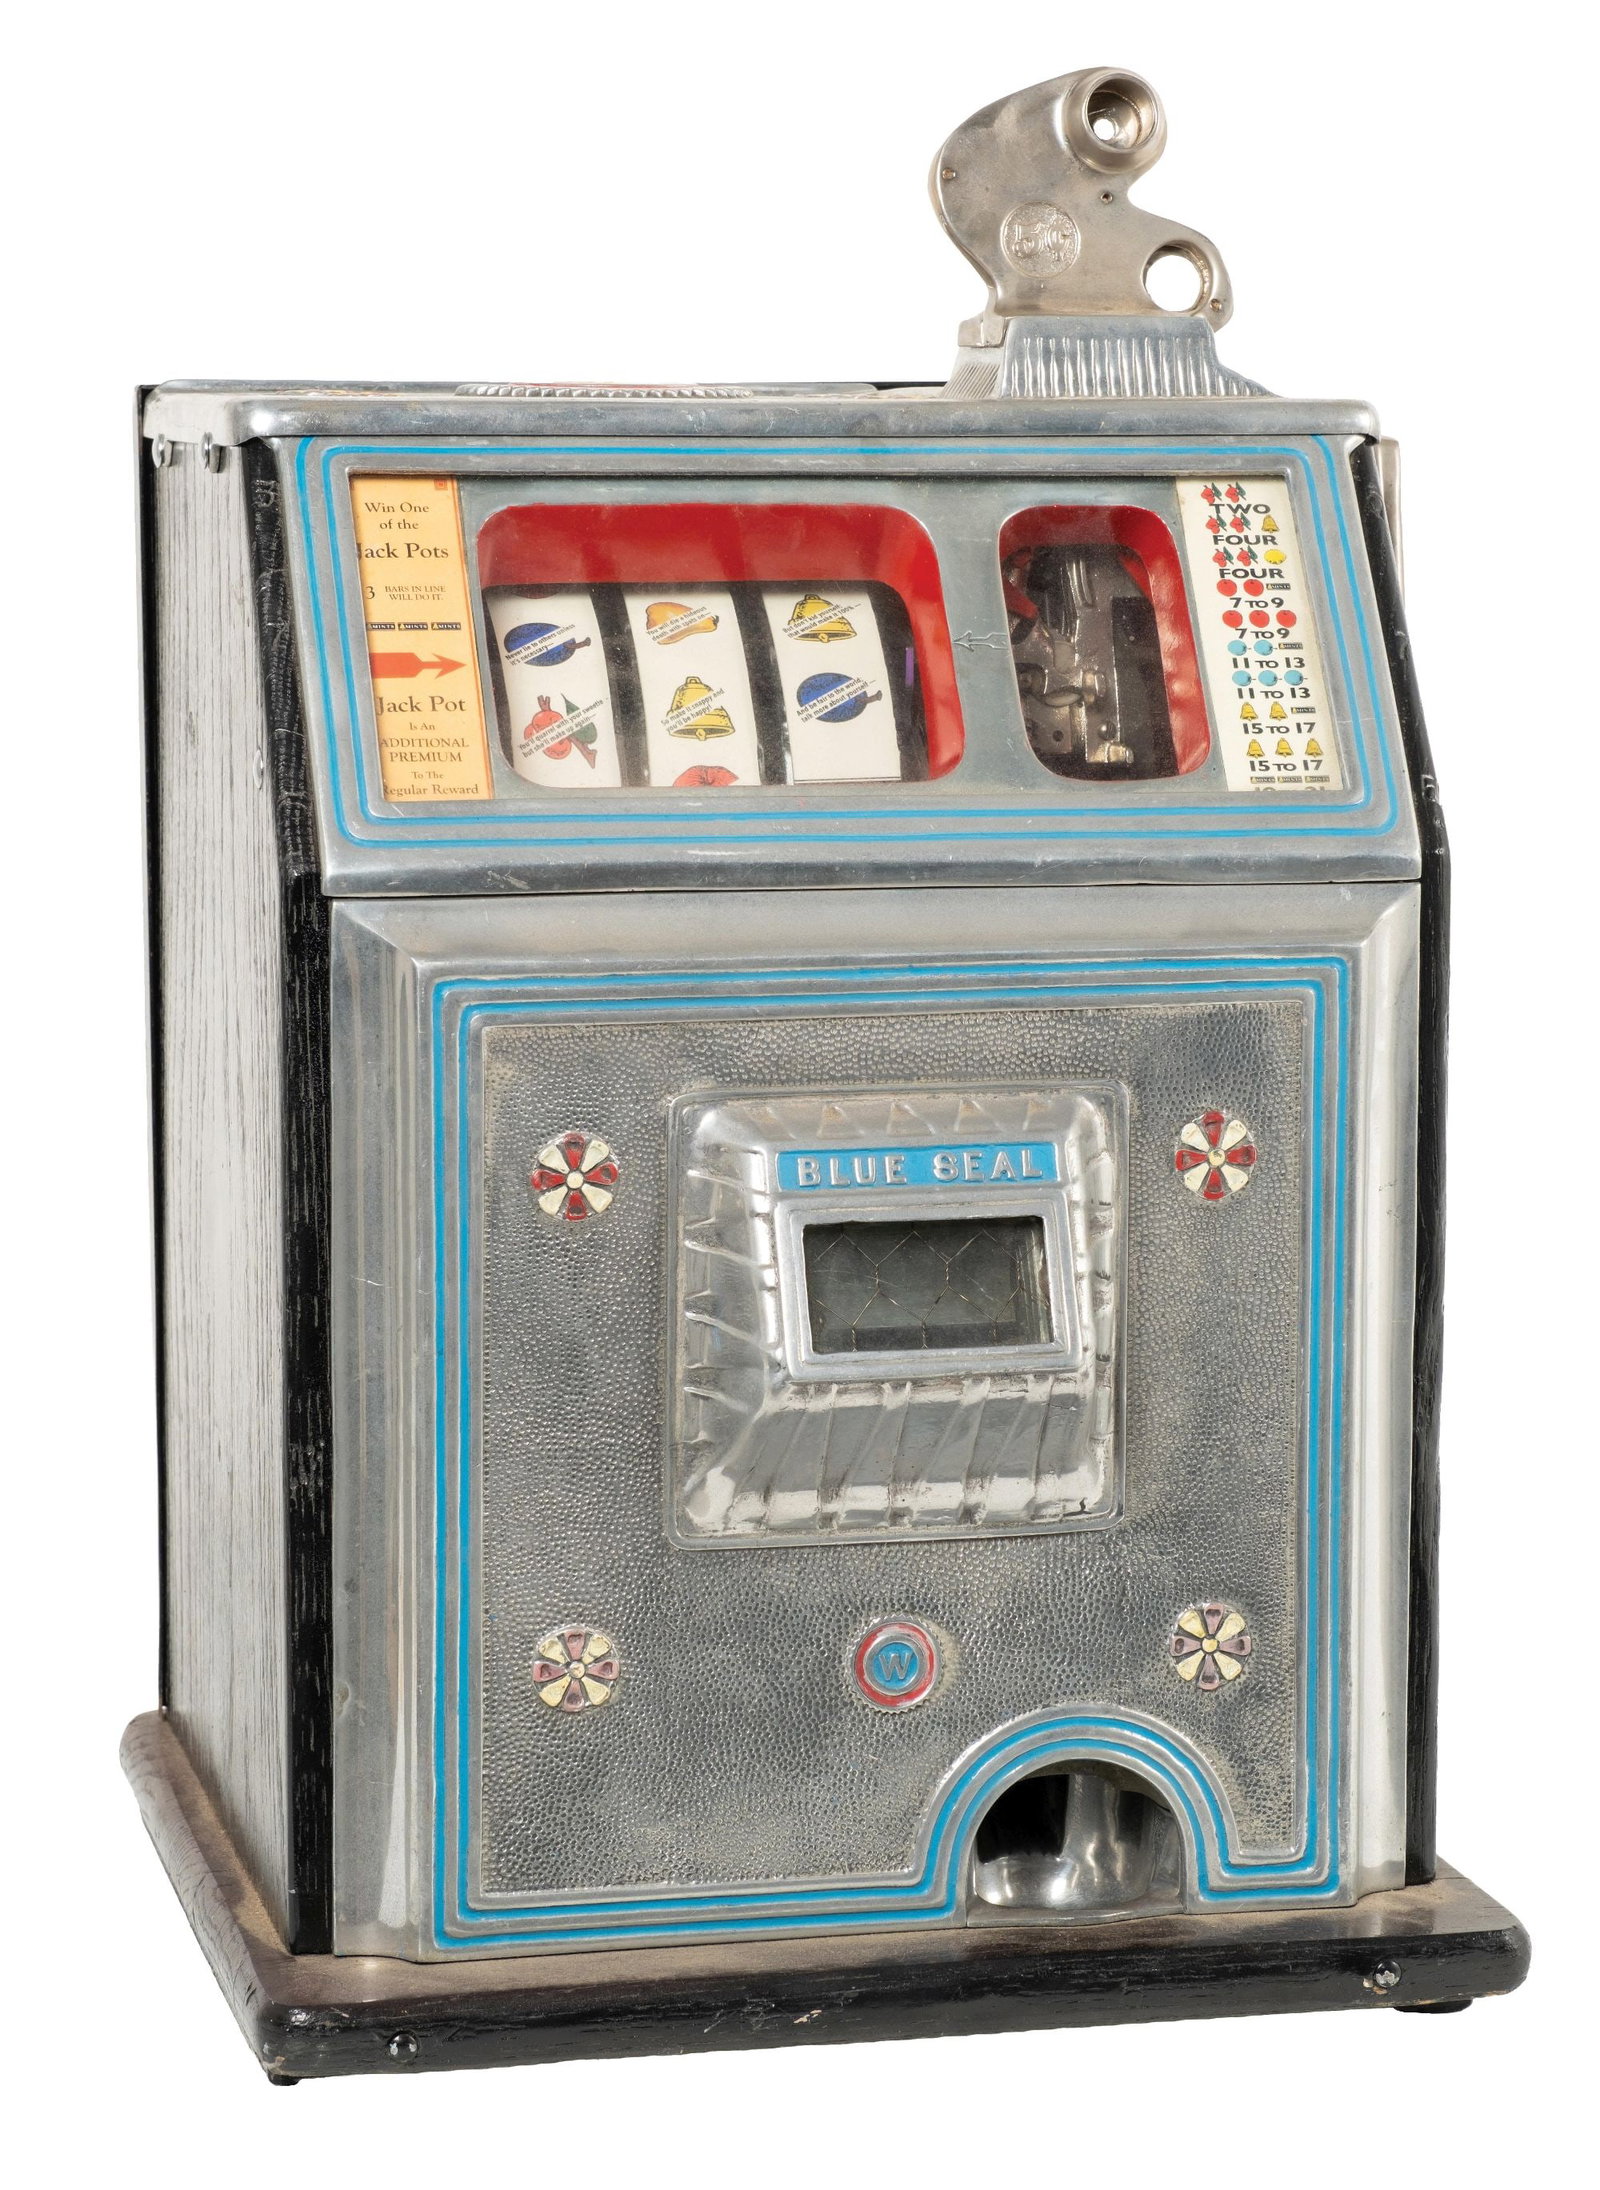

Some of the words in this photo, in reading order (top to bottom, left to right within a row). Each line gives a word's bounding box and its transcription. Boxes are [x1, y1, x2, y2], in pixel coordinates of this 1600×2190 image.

[364, 502, 395, 513] Win
[400, 502, 430, 513] One
[1209, 503, 1271, 514] TWO
[380, 519, 394, 530] of
[397, 519, 419, 530] the
[1213, 535, 1278, 545] FOUR
[356, 542, 399, 561] Jack
[404, 542, 449, 559] Pots
[1219, 568, 1285, 579] FOUR
[366, 586, 375, 600] 3
[1229, 598, 1242, 608] 7
[1245, 600, 1269, 609] TO
[1271, 597, 1284, 608] 9
[800, 622, 818, 632] would
[817, 615, 833, 624] make
[1235, 628, 1248, 639] 7
[1250, 630, 1274, 639] TO
[1277, 628, 1290, 639] 9
[505, 649, 523, 660] Never
[538, 632, 557, 644] others
[557, 624, 576, 635] unless
[1232, 658, 1250, 669] 11
[1255, 660, 1279, 669] TO
[1285, 657, 1306, 668] 13
[1237, 688, 1255, 699] 11
[1260, 690, 1284, 699] TO
[1290, 687, 1311, 698] 13
[376, 696, 422, 715] Jack
[429, 695, 467, 712] Pot
[670, 709, 686, 721] make
[692, 696, 713, 709] snappy
[713, 688, 725, 697] and
[796, 706, 809, 716] And
[809, 702, 817, 710] be
[817, 696, 828, 706] fair
[834, 687, 845, 695] the
[801, 713, 813, 723] talk
[813, 704, 829, 716] more
[829, 695, 846, 707] about
[409, 722, 418, 731] Is
[420, 722, 435, 731] An
[535, 726, 556, 743] quarrel
[556, 719, 569, 729] with
[569, 712, 582, 723] your
[1242, 723, 1264, 734] 15
[1266, 725, 1290, 734] TO
[1296, 722, 1316, 734] 17
[380, 738, 469, 748] ADDITIONAL
[522, 749, 535, 758] but
[549, 731, 566, 743] make
[566, 725, 574, 733] up
[390, 752, 463, 762] PREMIUM
[1249, 760, 1270, 772] 15
[1272, 763, 1297, 771] TO
[1303, 759, 1323, 771] 17
[411, 771, 424, 779] To
[426, 771, 444, 779] The
[432, 783, 479, 794] Reward
[797, 1154, 907, 1187] BLUE
[933, 1149, 1043, 1181] SEAL
[878, 1651, 914, 1680] W
